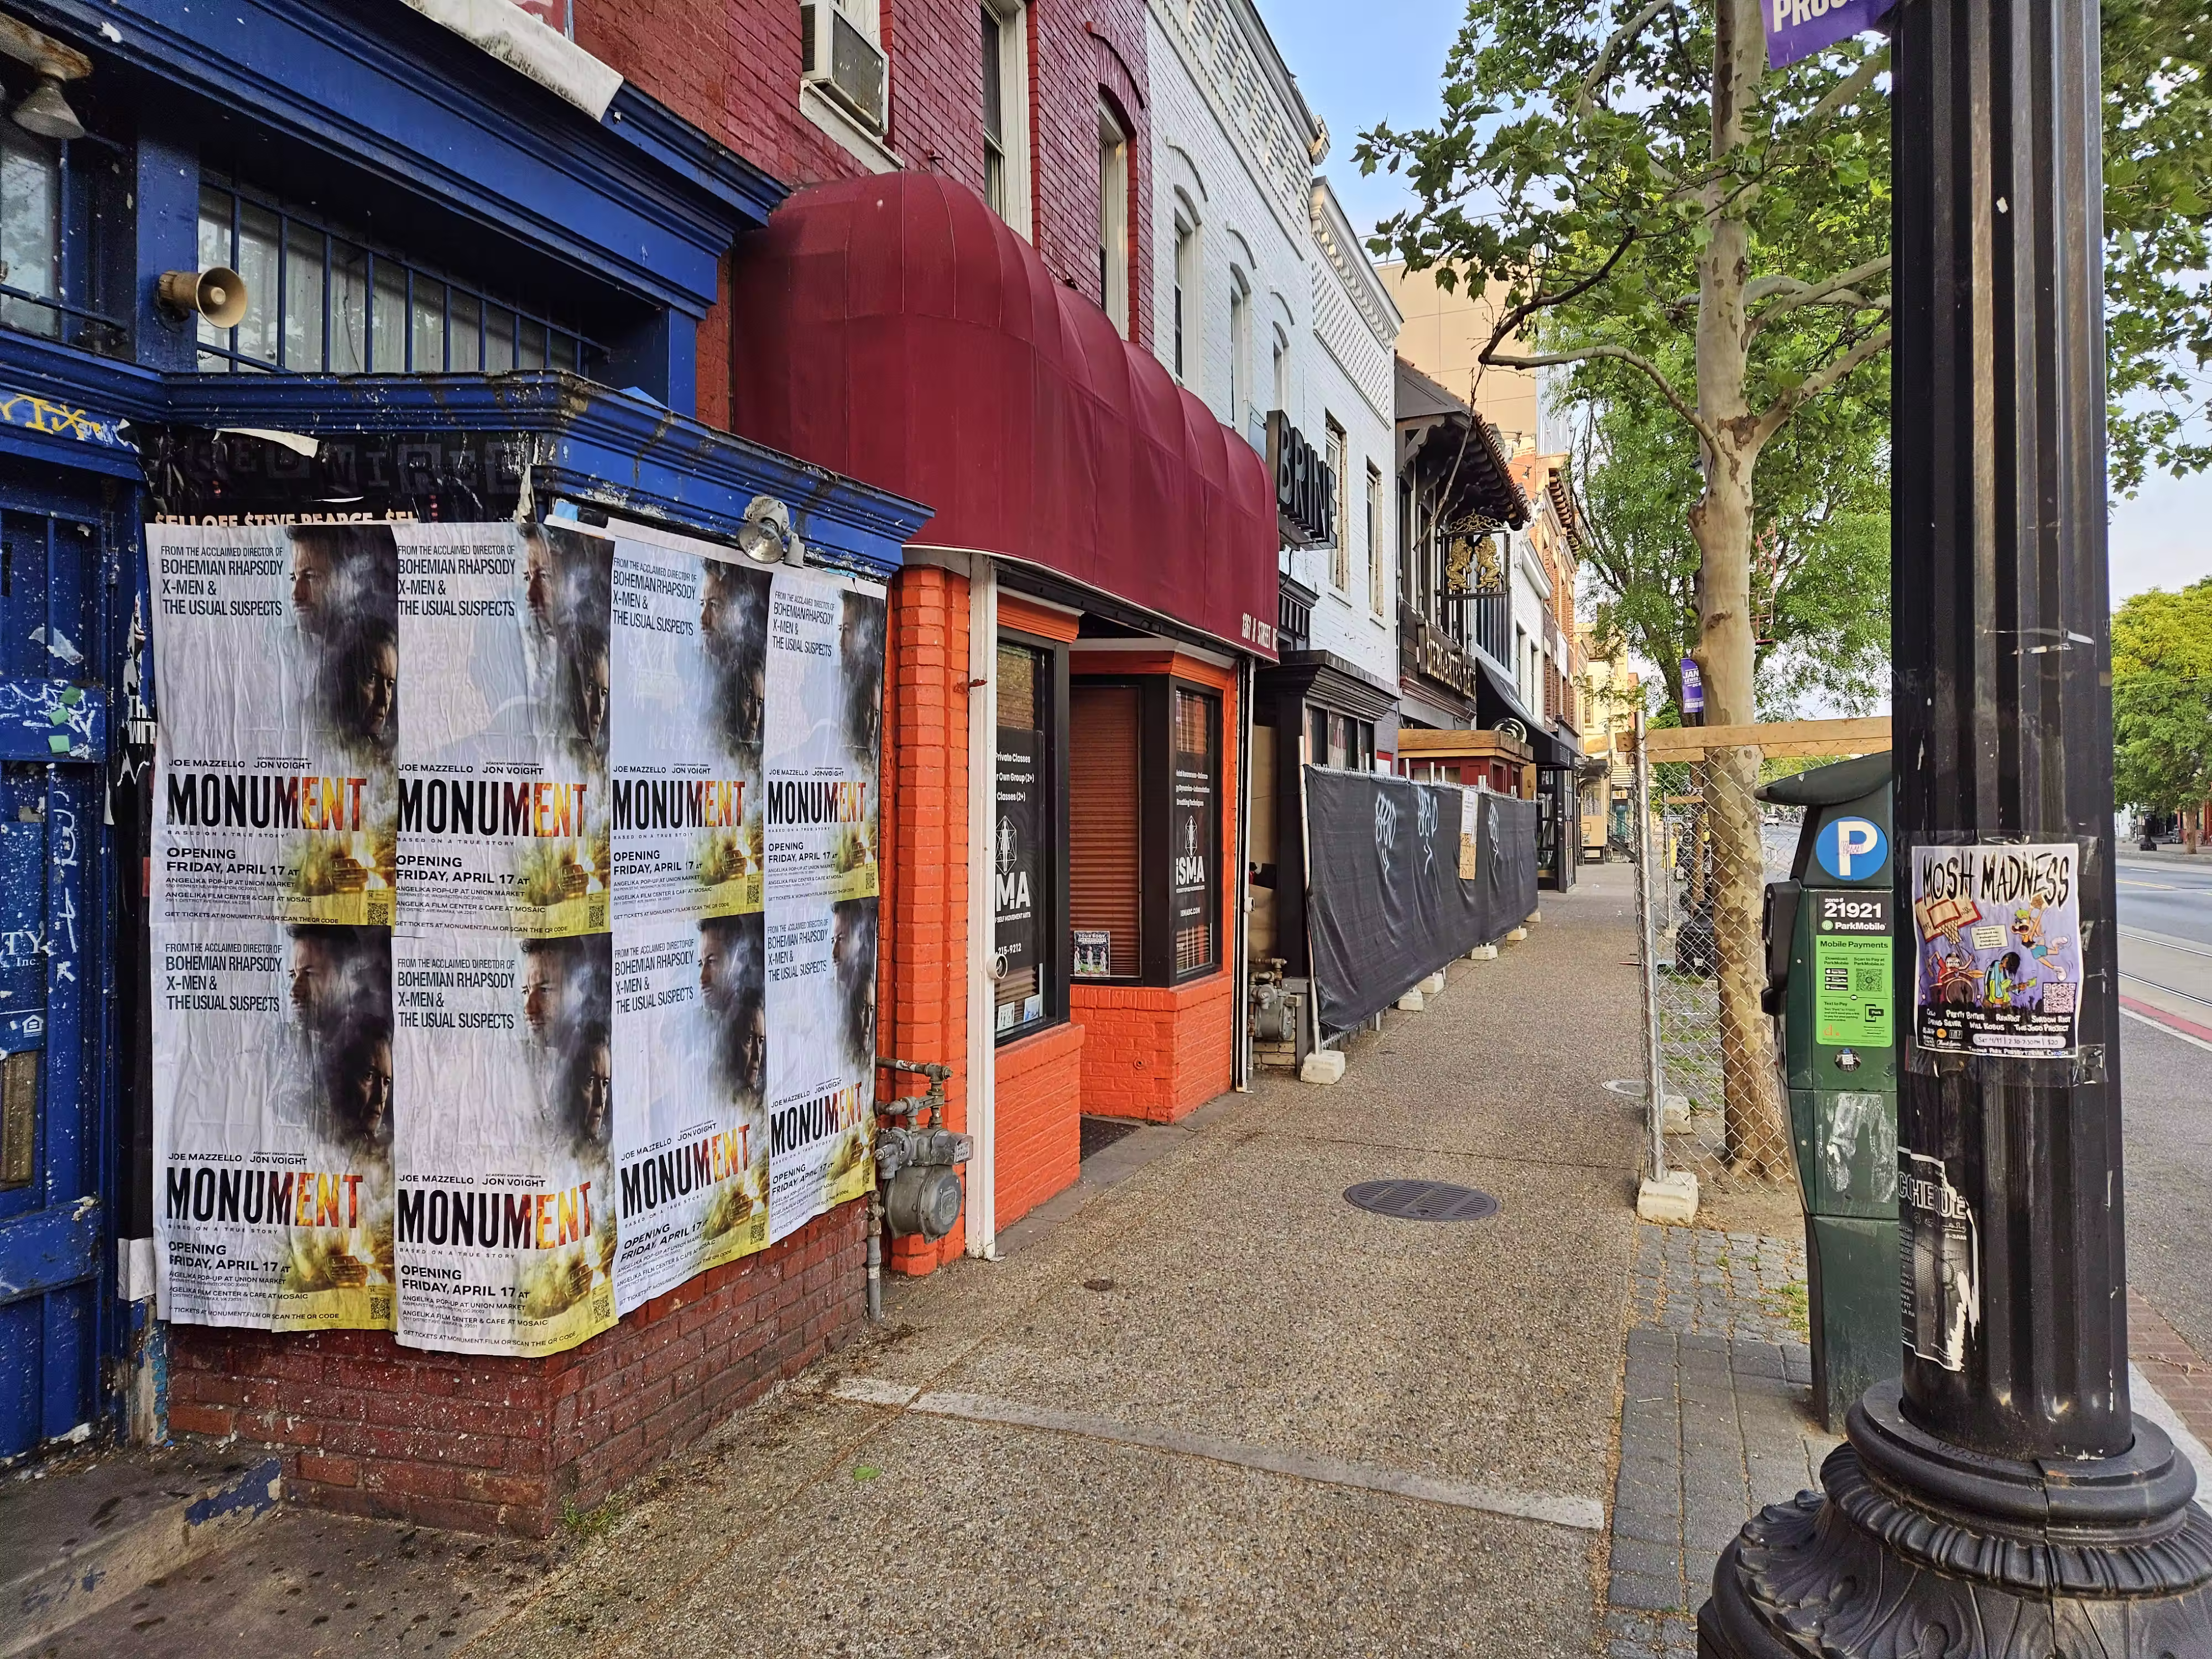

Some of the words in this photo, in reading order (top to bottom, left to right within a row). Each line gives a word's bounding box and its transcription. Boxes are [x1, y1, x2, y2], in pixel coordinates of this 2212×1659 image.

[161, 545, 184, 556] FROM
[186, 546, 199, 556] THE
[201, 547, 241, 557] ACCLAIMED
[243, 547, 274, 557] DIRECTOR
[276, 547, 283, 557] OF
[161, 559, 226, 576] BOHEMIAN
[229, 560, 283, 576] RHAPSODY
[398, 559, 456, 575] BOHEMIAN
[458, 559, 515, 575] RHAPSODY
[162, 580, 204, 595] X-MEN
[208, 580, 217, 595] &
[613, 570, 656, 592] BOHEMIAN
[656, 577, 696, 600] RHAPSODY
[163, 599, 186, 615] THE
[189, 599, 228, 616] USUAL
[230, 601, 283, 616] SUSPECTS
[1253, 618, 1256, 643] H
[1258, 620, 1271, 649] STREET
[1012, 753, 1031, 763] Classes
[999, 772, 1010, 781] Own
[1010, 773, 1025, 784] Group
[1025, 773, 1034, 783] (2+)
[166, 773, 367, 832] MONUMENT
[768, 781, 866, 825] MONUMENT
[997, 791, 1016, 801] Classes
[1016, 791, 1025, 802] (2+)
[397, 778, 587, 837] MONUMENT
[612, 779, 745, 831] MONUMENT
[166, 847, 236, 860] OPENING
[768, 842, 804, 852] OPENING
[1838, 821, 1877, 876] P
[768, 853, 797, 864] FRIDAY,
[799, 852, 820, 861] APRIL
[822, 852, 831, 860] 17
[166, 861, 223, 874] FRIDAY,
[226, 863, 267, 875] APRIL
[270, 865, 285, 875] 17
[1923, 850, 1975, 907] MOSH
[1980, 851, 2070, 909] MADNESS
[1005, 913, 1023, 922] MOVEMENT
[1824, 902, 1881, 918] 21921
[1835, 922, 1886, 930] ParkMobile
[615, 957, 655, 976] BOHEMIAN
[656, 950, 694, 970] RHAPSODY
[166, 995, 191, 1010] THE
[192, 995, 227, 1010] USUAL
[229, 996, 279, 1013] SUSPECTS
[398, 992, 434, 1008] X-MEN
[436, 992, 444, 1008] &
[770, 1081, 862, 1159] MONUMENT
[620, 1123, 750, 1220] MONUMENT
[772, 1163, 806, 1185] OPENING
[422, 1175, 474, 1185] MAZZELLO
[507, 1178, 546, 1187] VOIGHT
[166, 1167, 363, 1228] MONUMENT
[398, 1181, 591, 1250] MONUMENT
[623, 1223, 670, 1250] OPENING
[403, 1295, 434, 1304] ANGELIKA
[436, 1298, 458, 1307] POP-UP
[415, 1331, 437, 1339] TICKETS
[447, 1336, 499, 1345] MONUMENT.FILM
[531, 1339, 546, 1347] THE
[547, 1337, 557, 1345] QR
[559, 1331, 576, 1341] CODE
